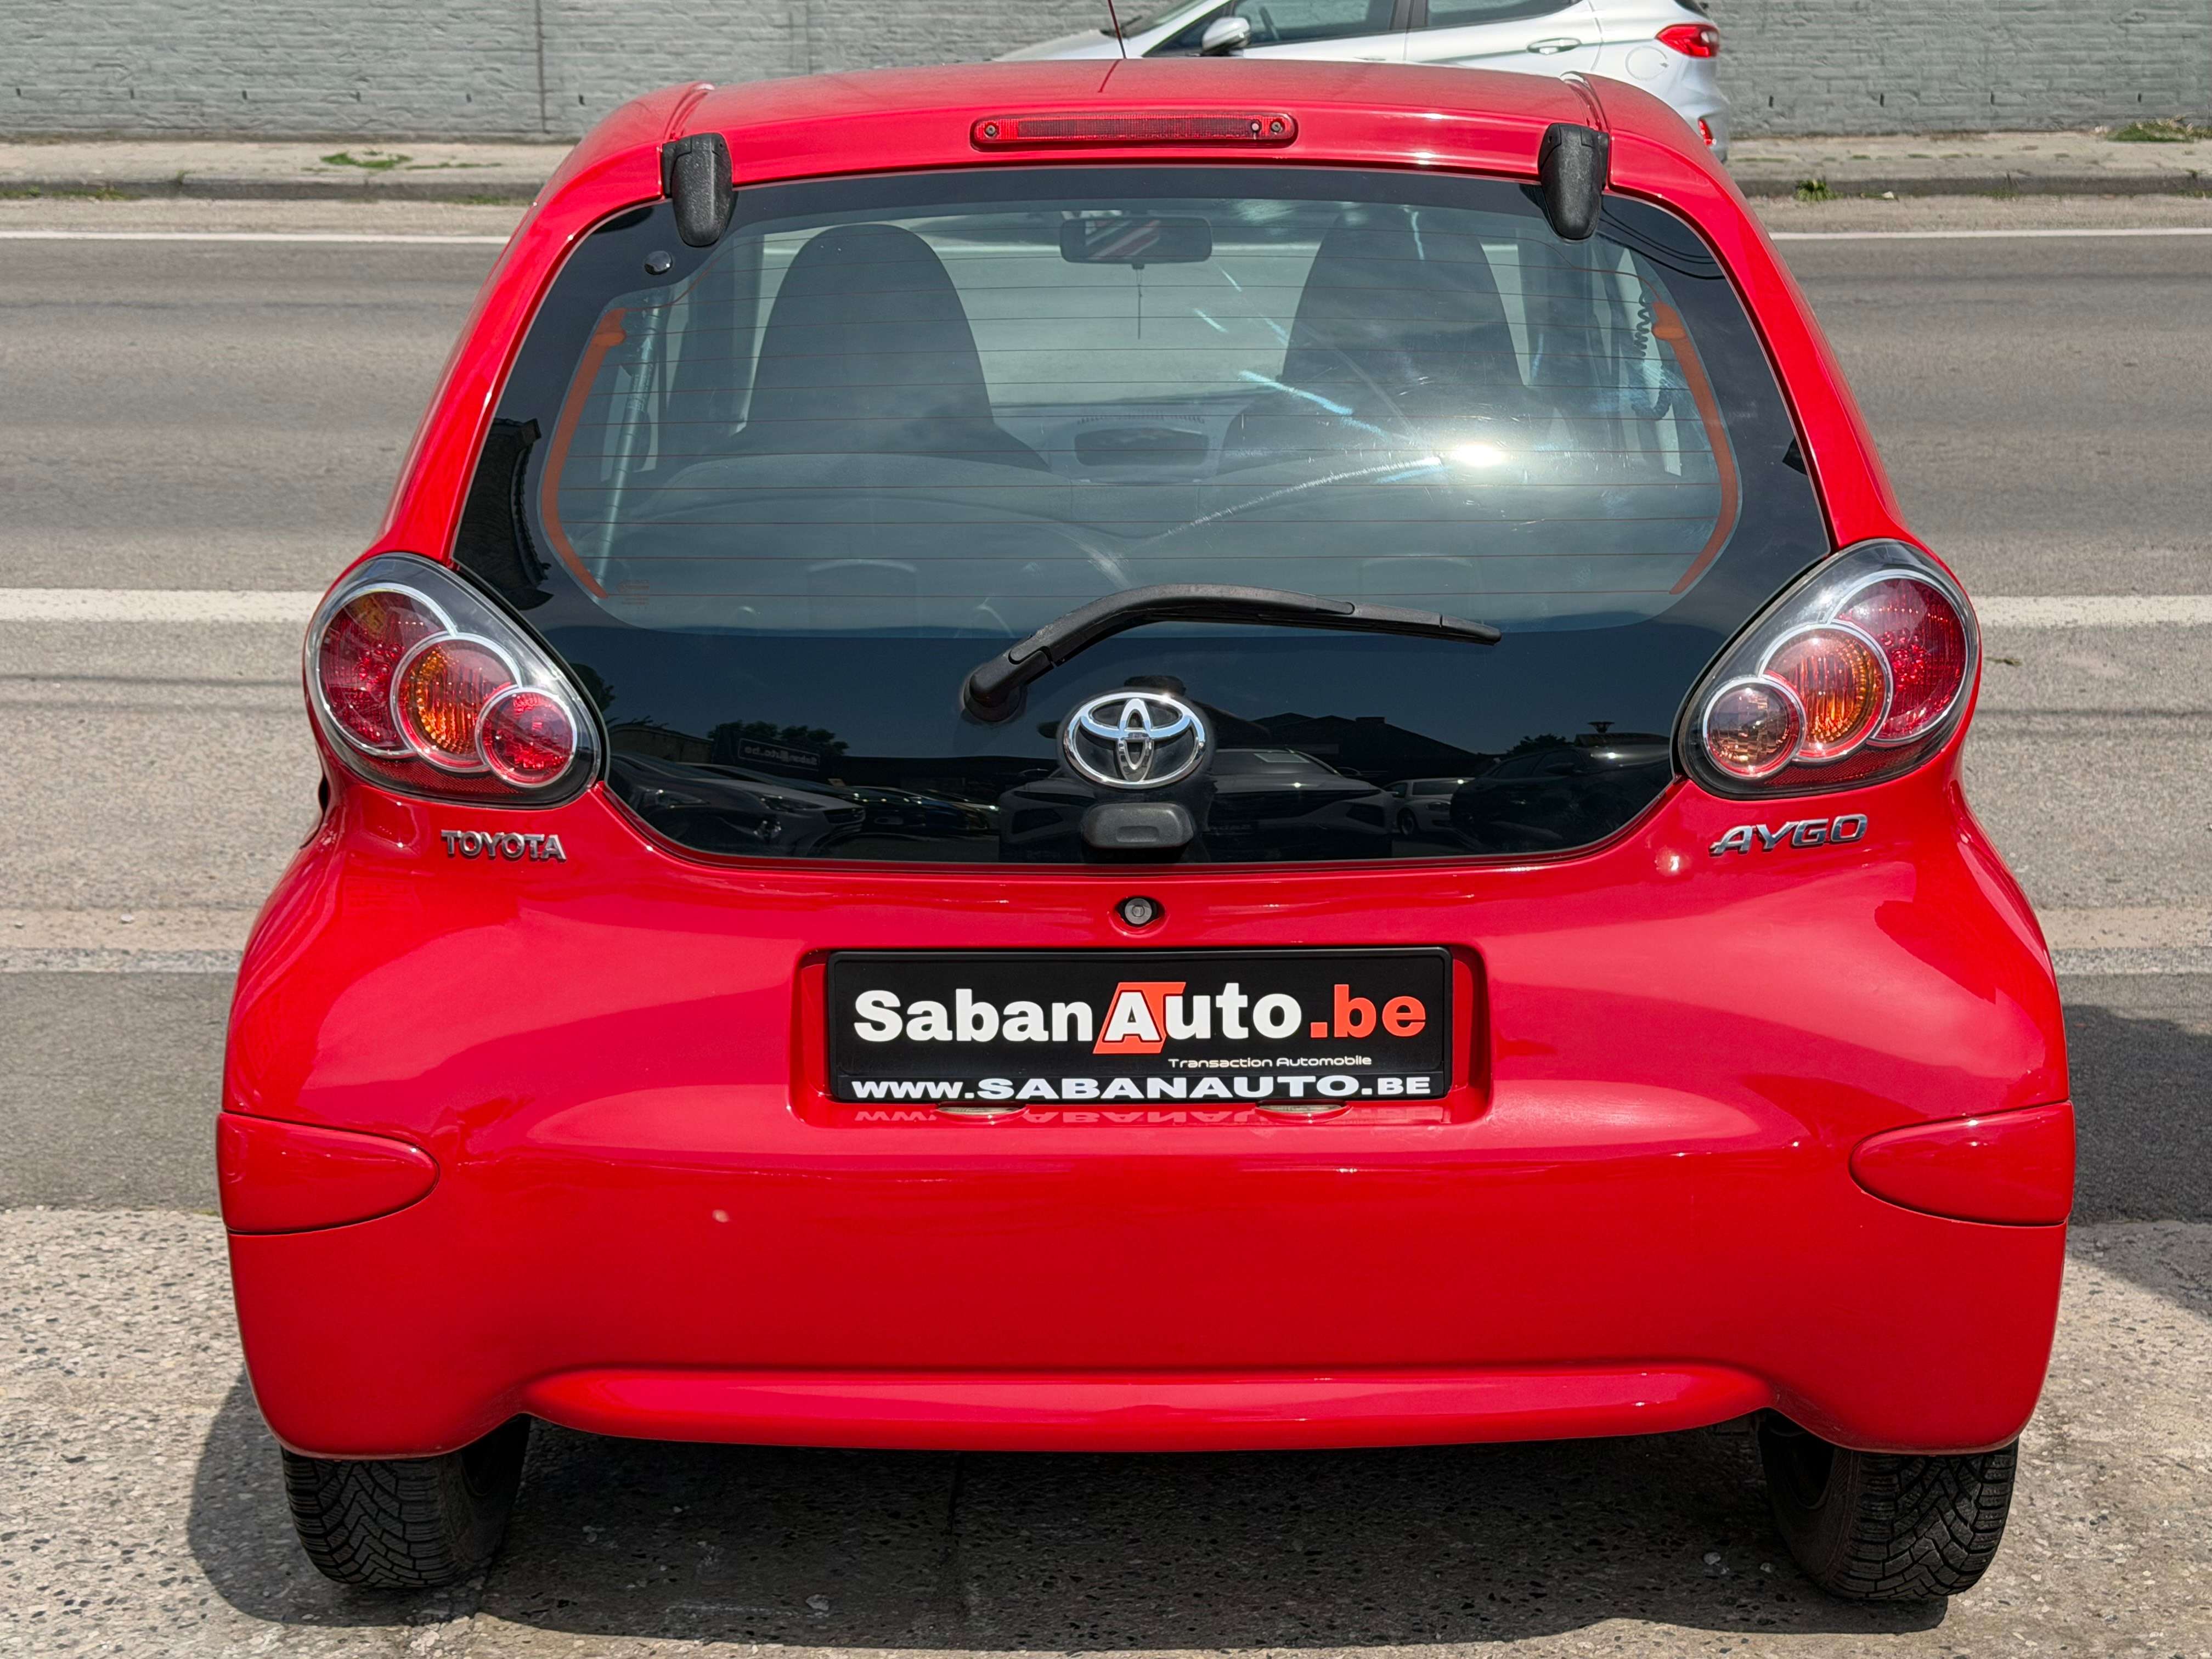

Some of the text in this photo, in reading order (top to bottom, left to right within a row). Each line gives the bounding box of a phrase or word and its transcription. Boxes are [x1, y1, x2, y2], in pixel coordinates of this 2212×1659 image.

[441, 829, 567, 861] TOYOTA
[1709, 814, 1867, 855] AYGO
[1168, 1055, 1372, 1069] Transaction Automobile
[851, 1075, 1431, 1099] www.SABANAUTO.BE
